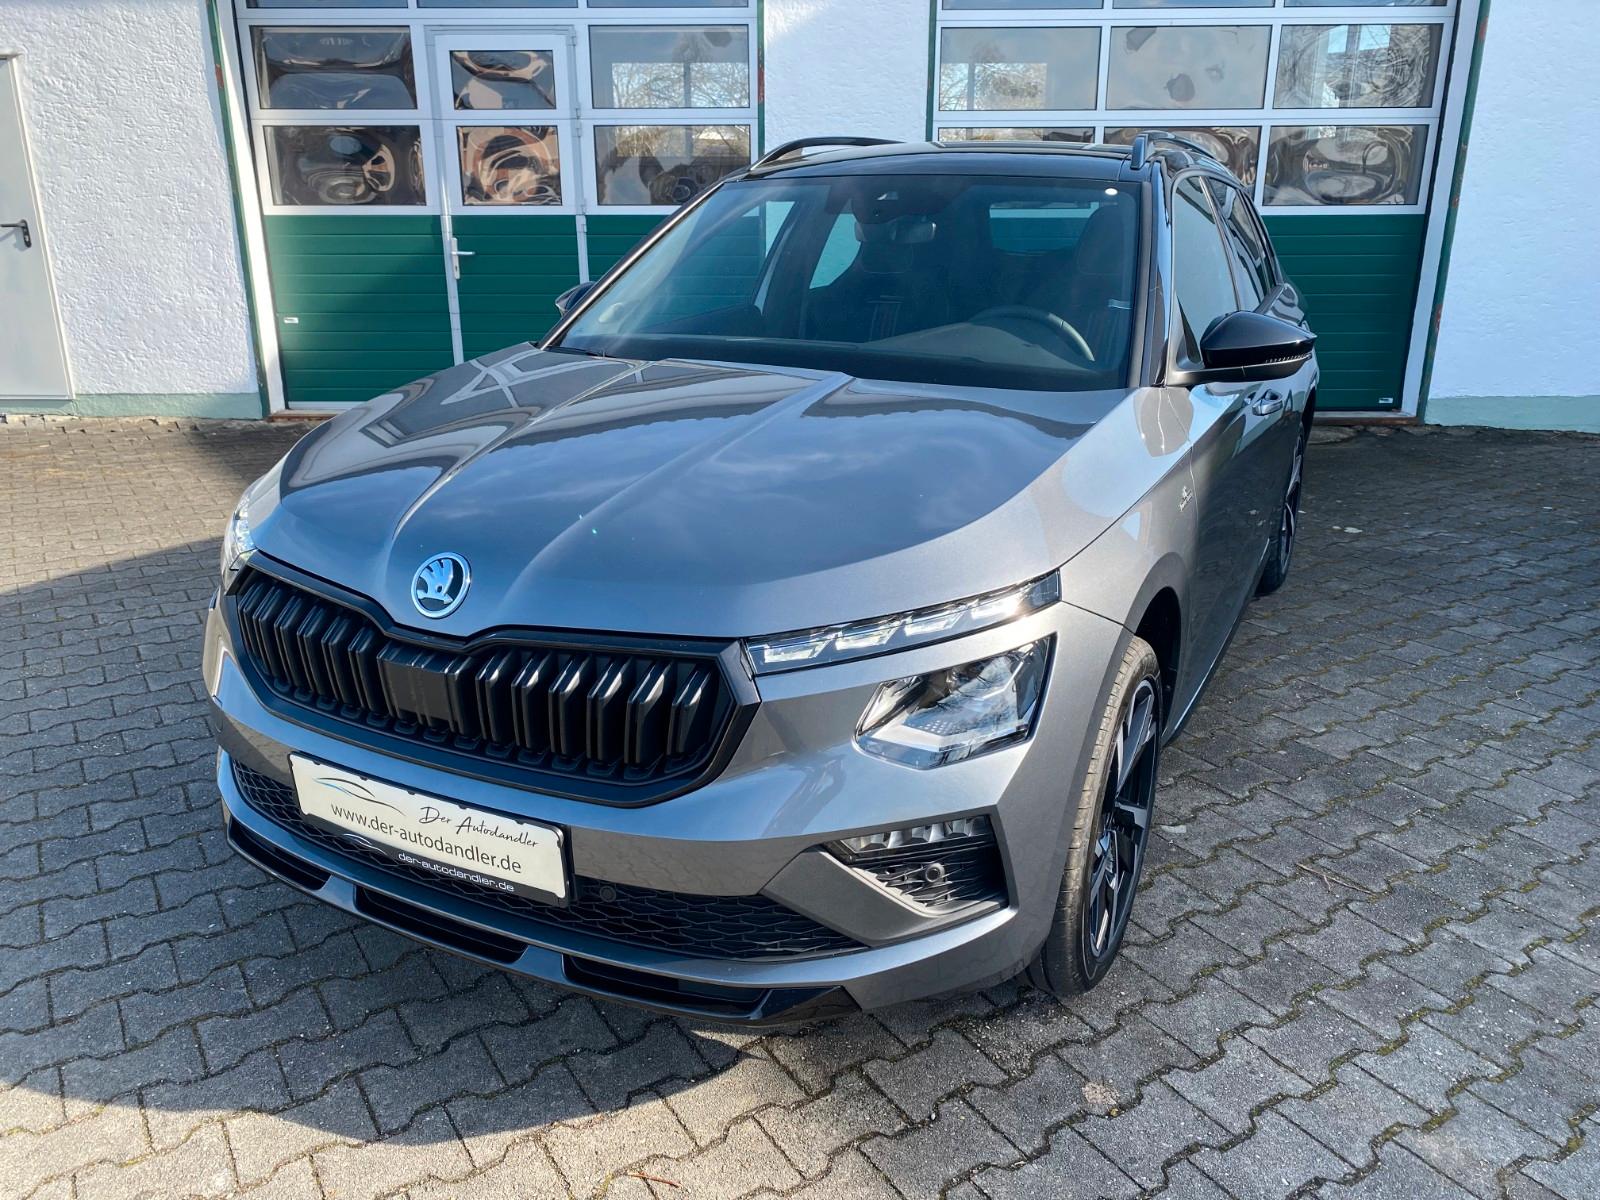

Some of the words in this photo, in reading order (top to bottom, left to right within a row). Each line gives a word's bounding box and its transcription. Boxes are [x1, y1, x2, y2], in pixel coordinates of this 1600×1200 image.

[331, 803, 522, 873] www.der-autodandler.de
[418, 806, 451, 824] Der
[456, 817, 539, 847] Autodandler
[398, 851, 515, 892] der-autodandler.de
